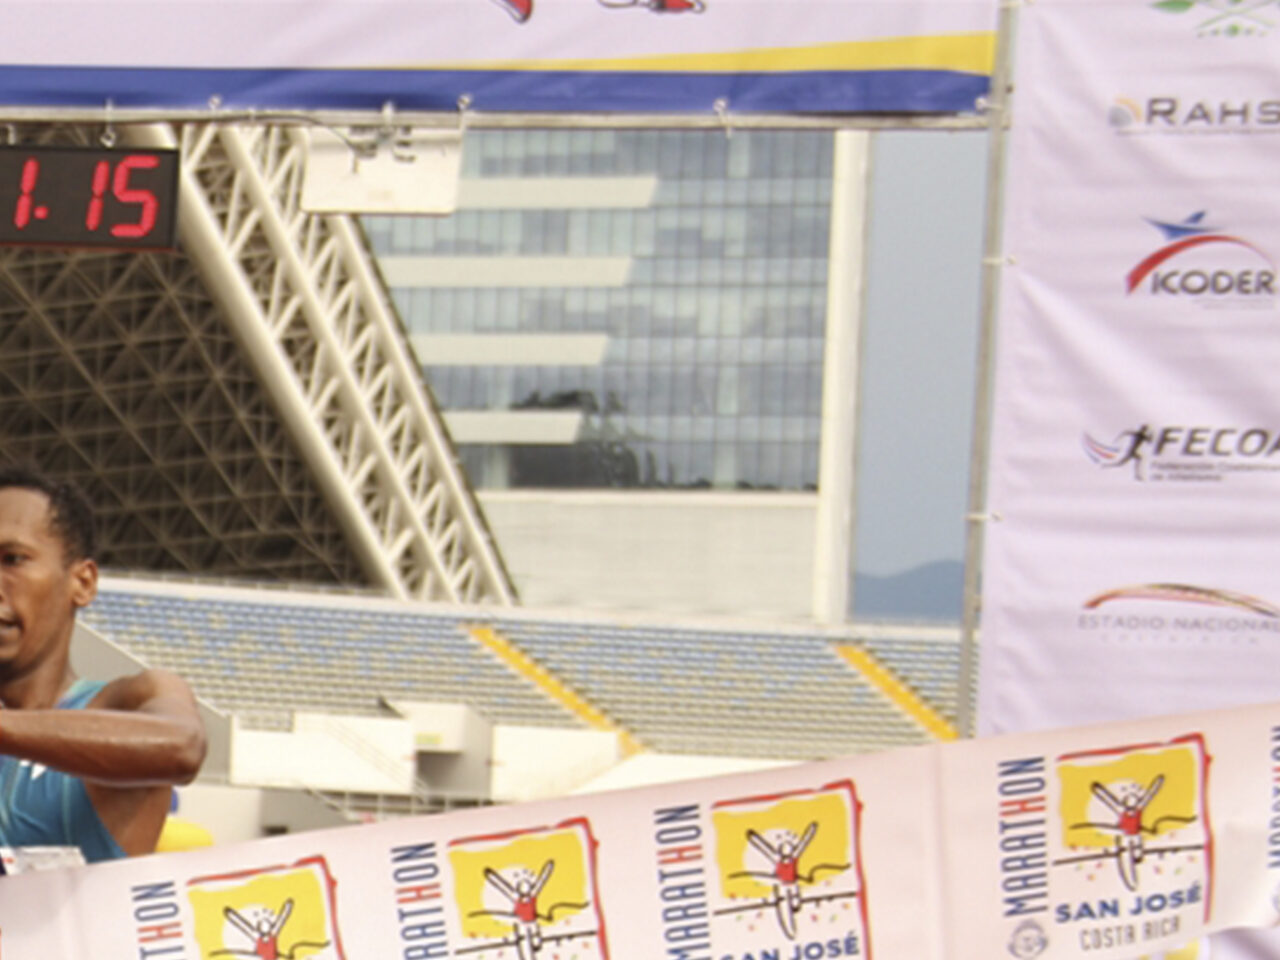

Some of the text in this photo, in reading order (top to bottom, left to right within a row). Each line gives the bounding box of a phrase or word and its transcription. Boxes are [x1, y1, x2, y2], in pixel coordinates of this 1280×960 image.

[1150, 269, 1275, 296] ICODER
[1077, 614, 1165, 630] ESTADIO
[998, 757, 1048, 918] MARATHON
[1055, 881, 1201, 924] SAN JOSÉ
[1080, 915, 1181, 951] COSTA RICA
